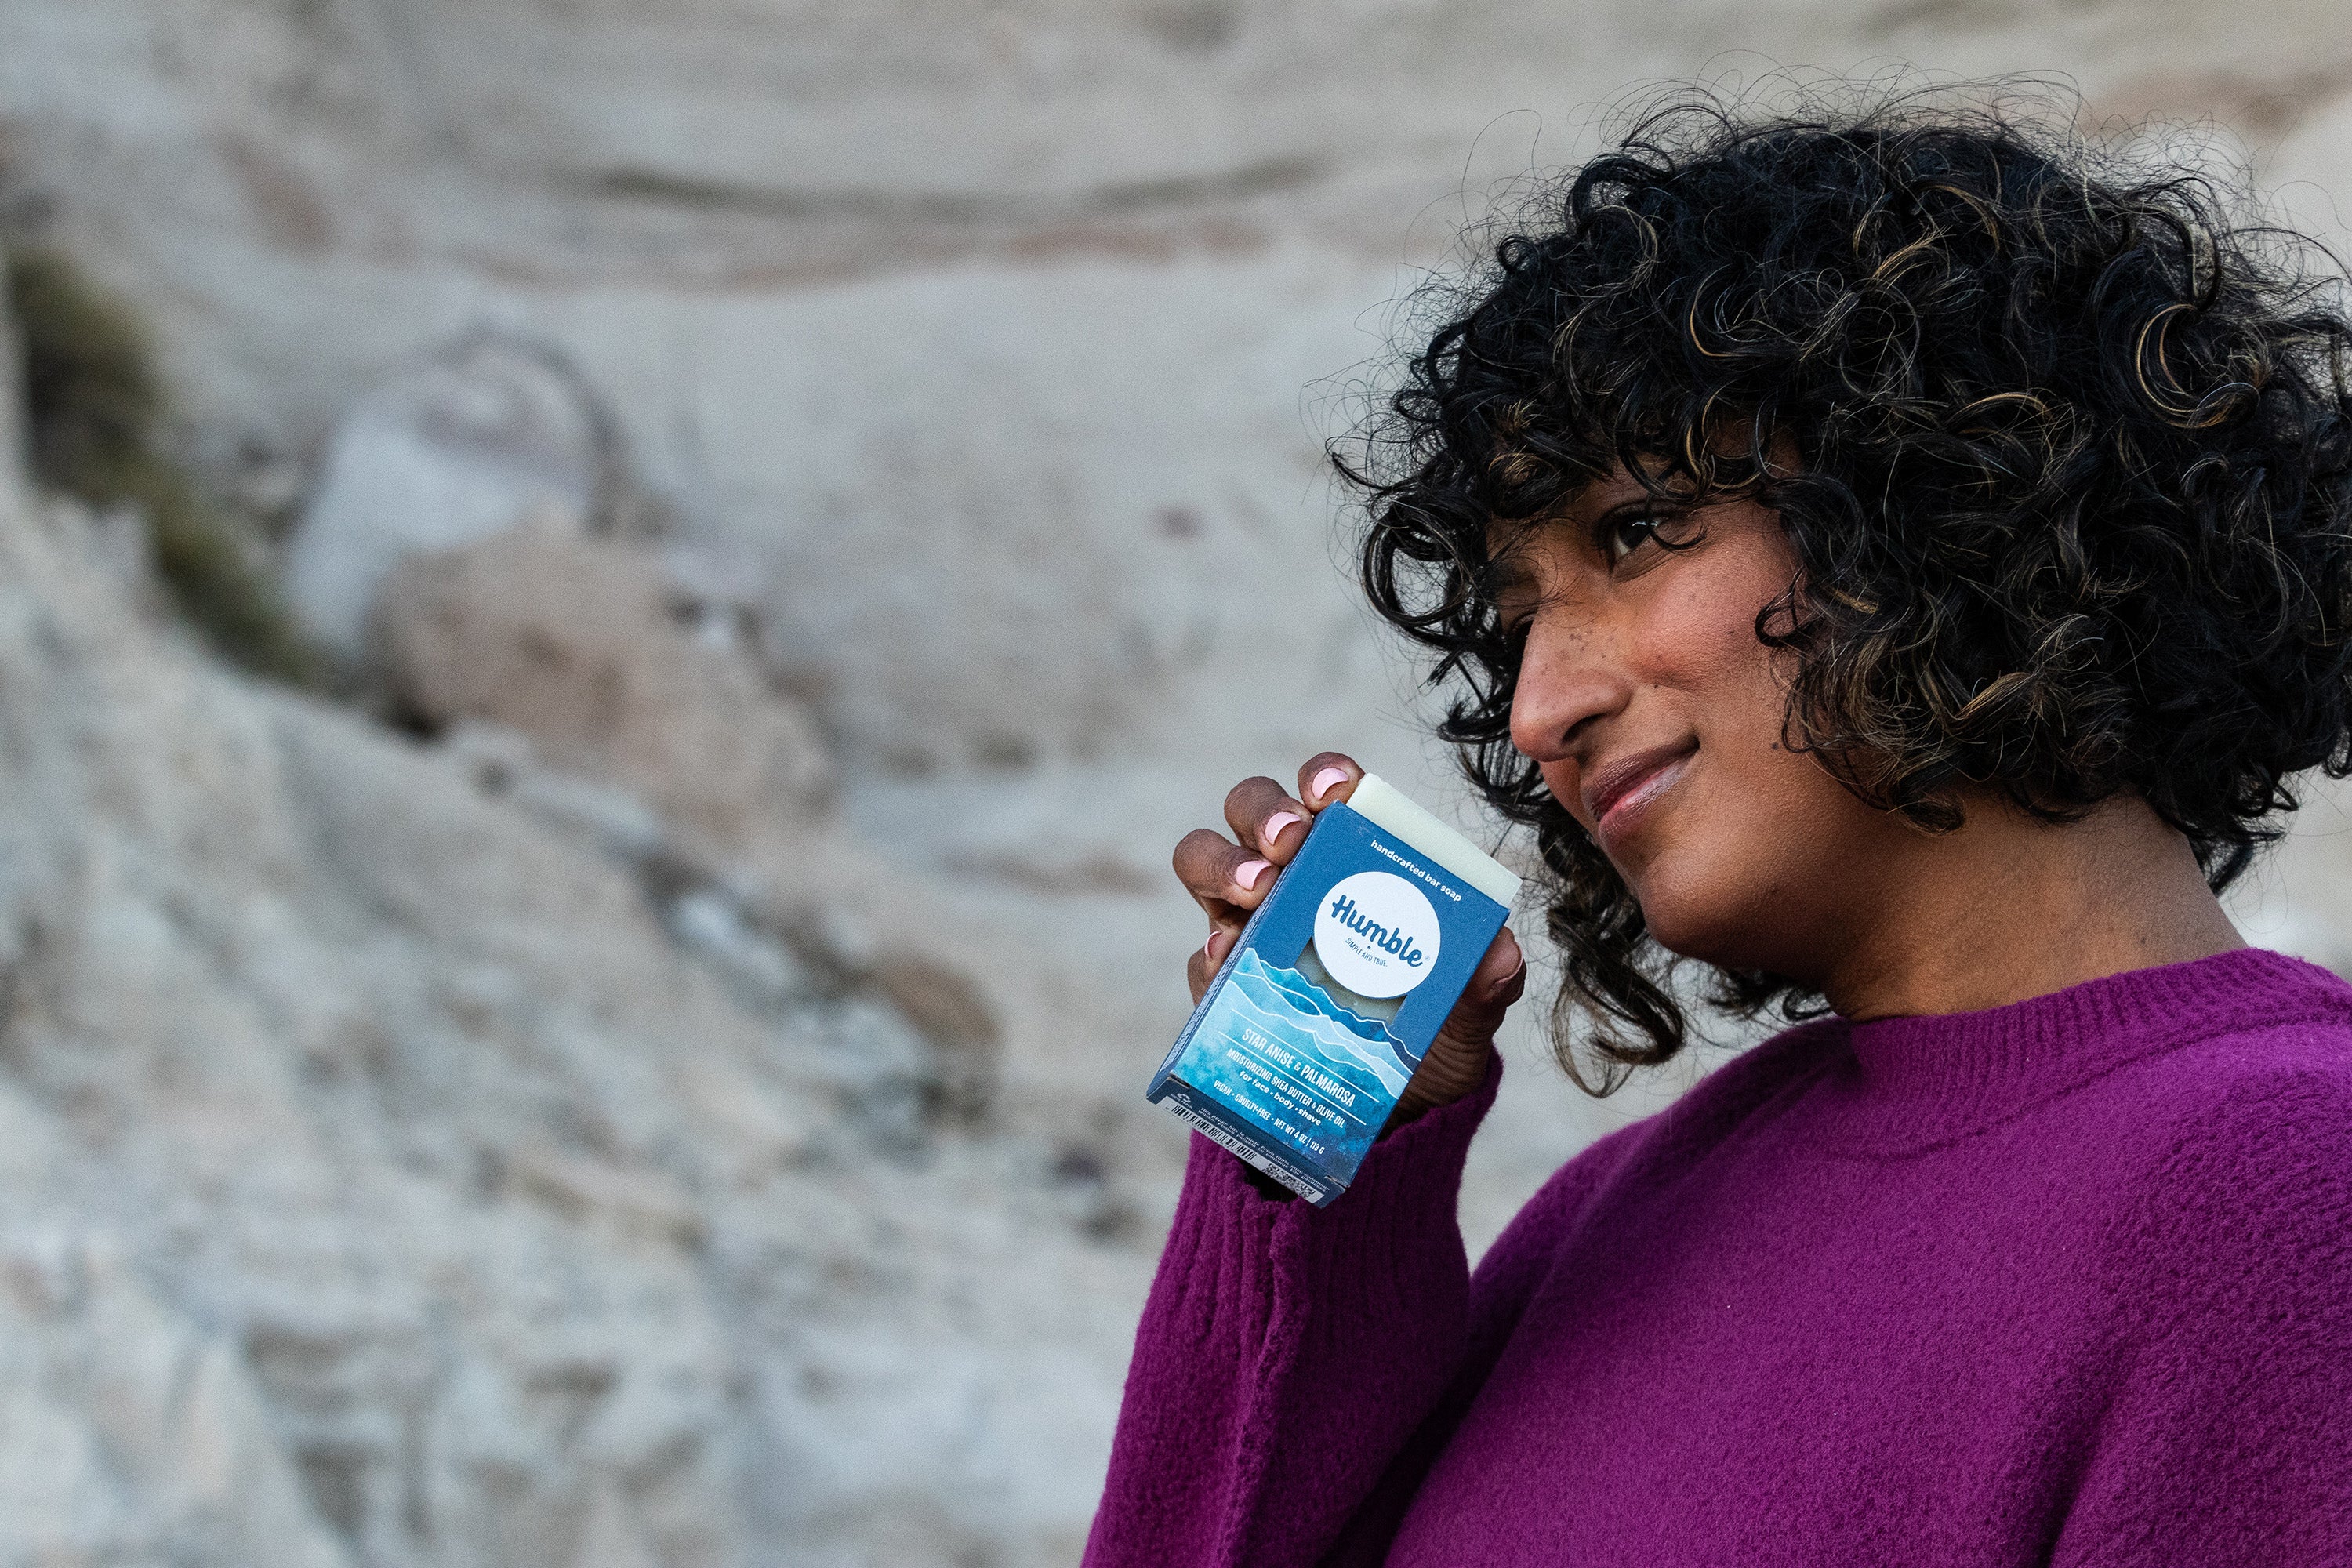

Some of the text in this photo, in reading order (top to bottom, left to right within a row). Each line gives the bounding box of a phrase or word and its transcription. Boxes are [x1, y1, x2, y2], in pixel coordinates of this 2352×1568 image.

[1370, 839, 1462, 902] handcrafted bar soap
[1331, 895, 1423, 967] Humble
[1345, 938, 1363, 955] SIMPLE
[1361, 952, 1372, 962] AND
[1226, 1047, 1272, 1082] MOISTURIZING
[1270, 1076, 1289, 1092] SHEA
[1287, 1086, 1312, 1107] BUTTER
[1315, 1104, 1335, 1121] OLIVE
[1333, 1115, 1346, 1128] OIL
[1238, 1070, 1321, 1126] for face body shave
[1241, 1027, 1356, 1107] STAR ANISE & PALMAROSA
[1212, 1080, 1232, 1096] VEGAN
[1234, 1093, 1271, 1120] CRUELTY-FREE
[1273, 1118, 1286, 1130] NET
[1283, 1124, 1294, 1135] WT
[1293, 1130, 1300, 1138] 4
[1298, 1134, 1308, 1143] OZ
[1309, 1141, 1319, 1151] 113
